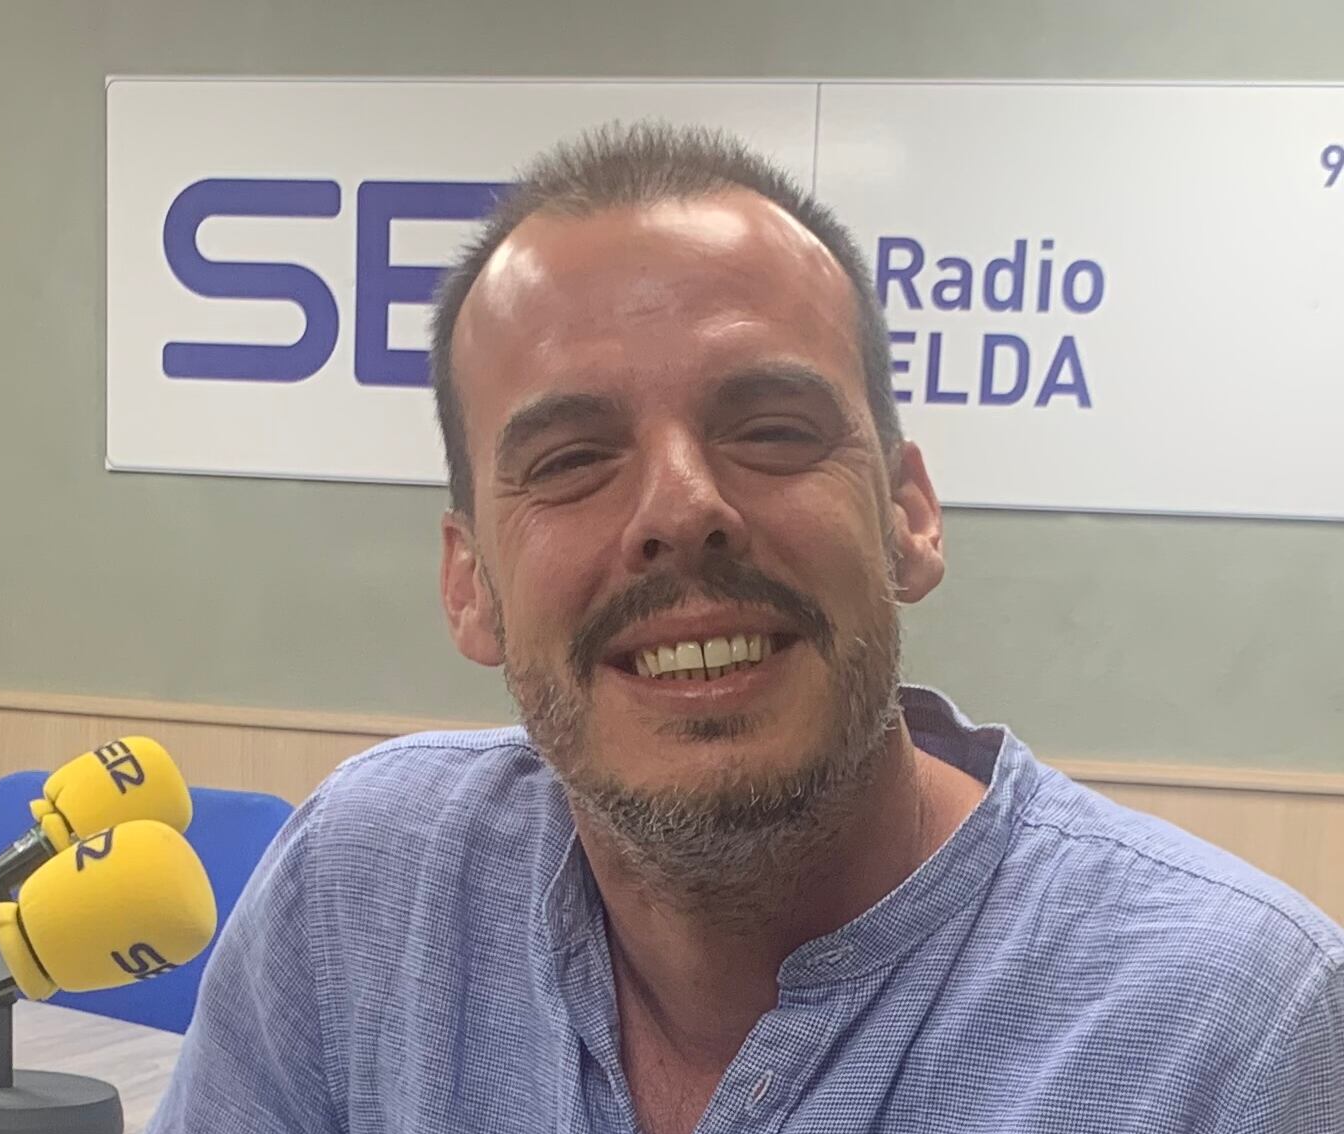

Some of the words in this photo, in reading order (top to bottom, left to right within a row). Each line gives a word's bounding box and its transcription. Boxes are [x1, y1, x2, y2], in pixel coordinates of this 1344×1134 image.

[162, 177, 514, 388] SE
[874, 236, 1106, 315] Radio
[94, 740, 145, 795] ER
